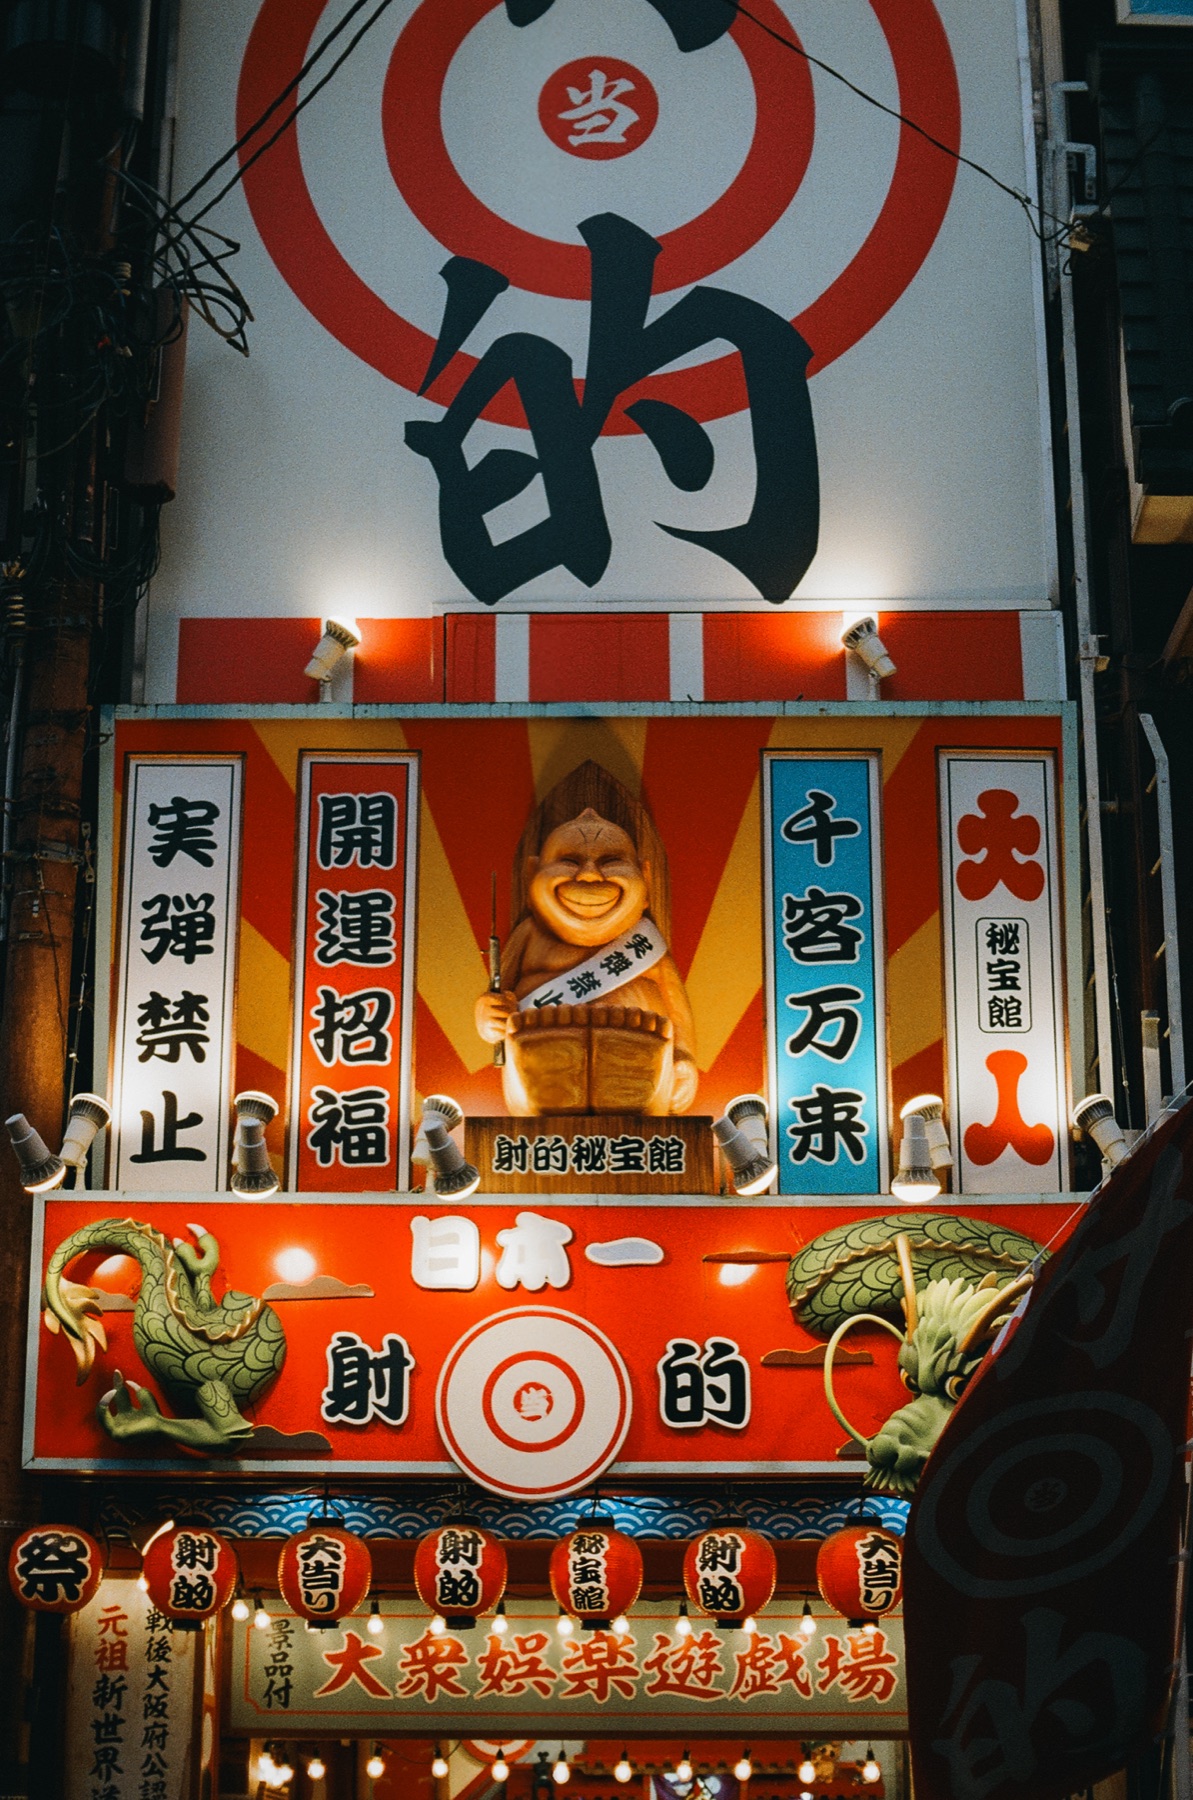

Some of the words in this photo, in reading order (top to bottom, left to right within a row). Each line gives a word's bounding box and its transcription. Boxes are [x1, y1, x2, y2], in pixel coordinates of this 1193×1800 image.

[557, 69, 642, 148] 当
[404, 212, 821, 605] 的
[129, 796, 220, 1164] 実弾禁止
[309, 794, 396, 1166] 開運招福
[533, 932, 654, 1010] 実弾禁止
[783, 790, 867, 1164] 千客万来
[985, 922, 1022, 1028] 秘宝館
[494, 1135, 685, 1173] 射的秘宝館
[411, 1212, 664, 1291] 日本一
[324, 1333, 413, 1424] 射
[661, 1339, 750, 1427] 的
[22, 1532, 90, 1602] 祭
[171, 1533, 215, 1610] 射的
[301, 1535, 345, 1613] 大当り
[438, 1530, 482, 1607] 射的
[571, 1532, 606, 1611] 秘宝館
[699, 1536, 742, 1611] 射的
[860, 1533, 900, 1611] 大当り
[263, 1617, 295, 1710] 景品付
[315, 1630, 899, 1702] 大衆娯楽遊戯場
